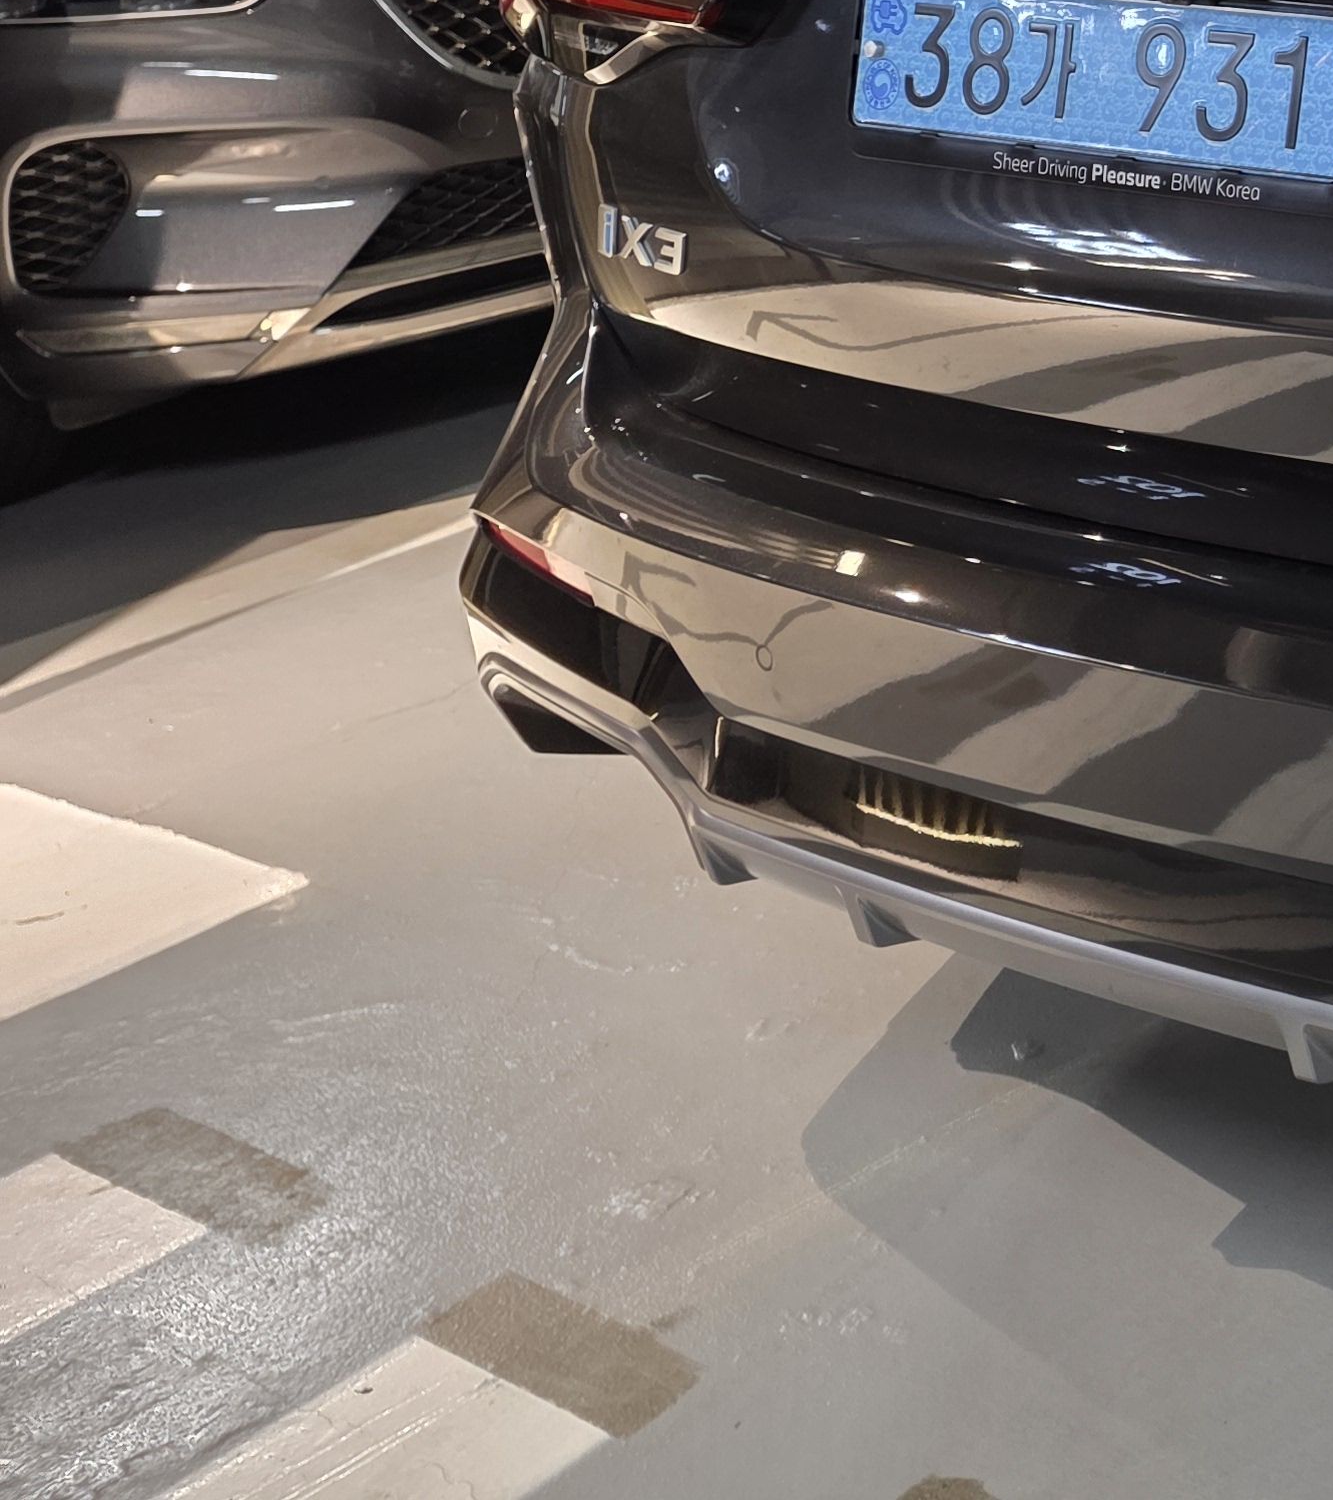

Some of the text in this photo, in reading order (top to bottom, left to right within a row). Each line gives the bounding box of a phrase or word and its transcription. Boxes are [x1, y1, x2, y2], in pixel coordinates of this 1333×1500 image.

[903, 2, 1077, 120] 38가
[993, 151, 1260, 201] Sheer Driving Pleasure BMW Korea
